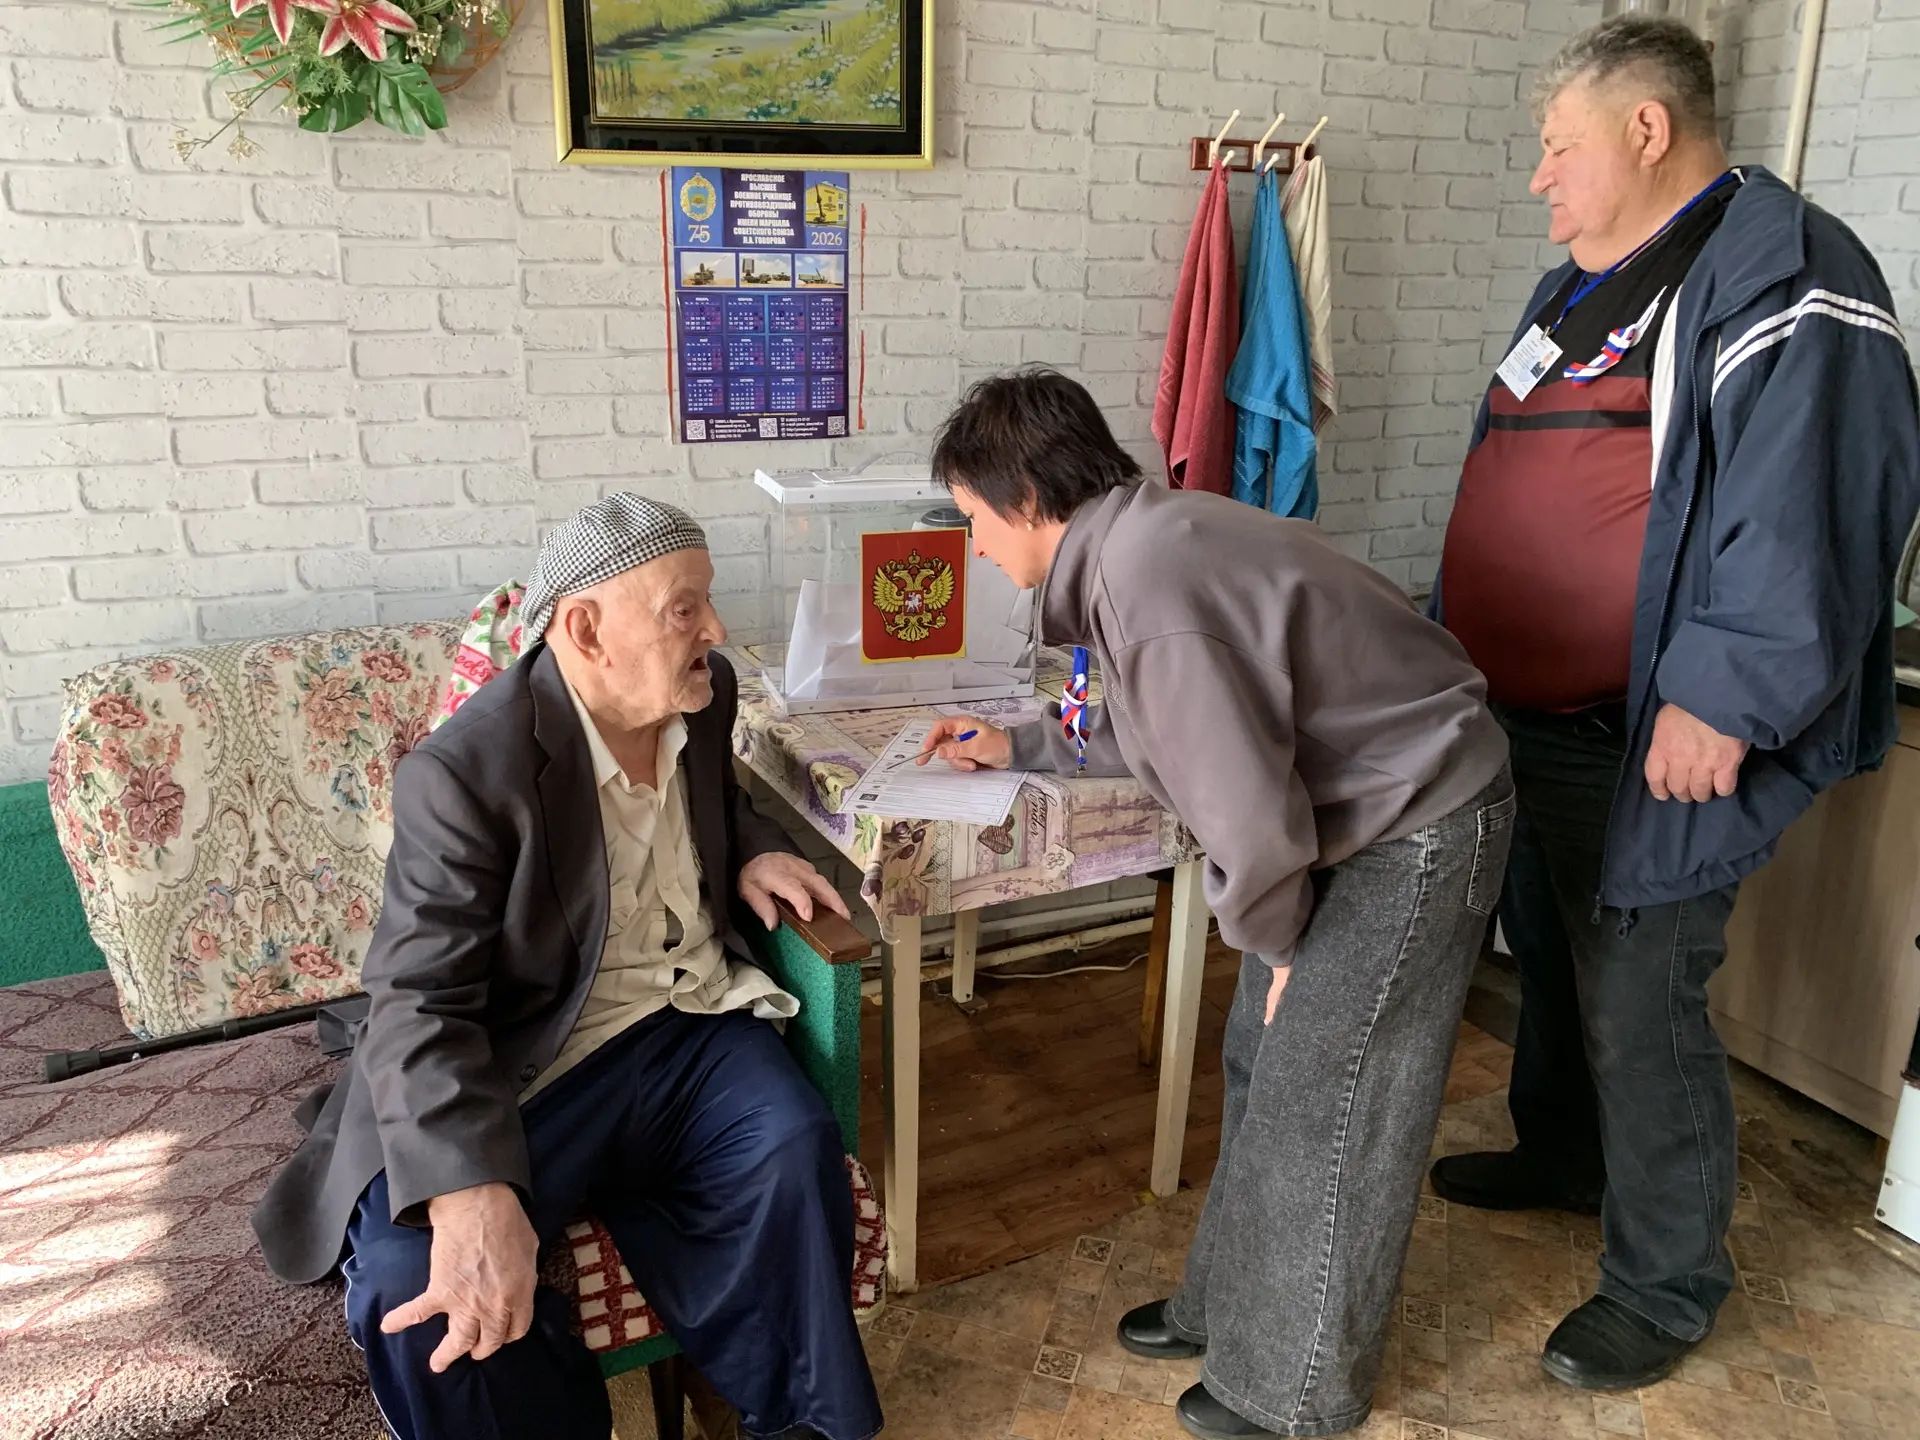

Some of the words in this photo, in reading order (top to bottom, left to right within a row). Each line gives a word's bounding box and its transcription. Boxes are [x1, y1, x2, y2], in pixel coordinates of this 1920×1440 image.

[749, 183, 776, 191] ВЫСШЕЕ
[748, 209, 778, 218] ОБОРОНЫ
[688, 224, 711, 243] 75
[733, 227, 771, 235] СОВЕТСКОГО
[772, 228, 794, 236] СОЮЗА
[811, 232, 842, 246] 2026
